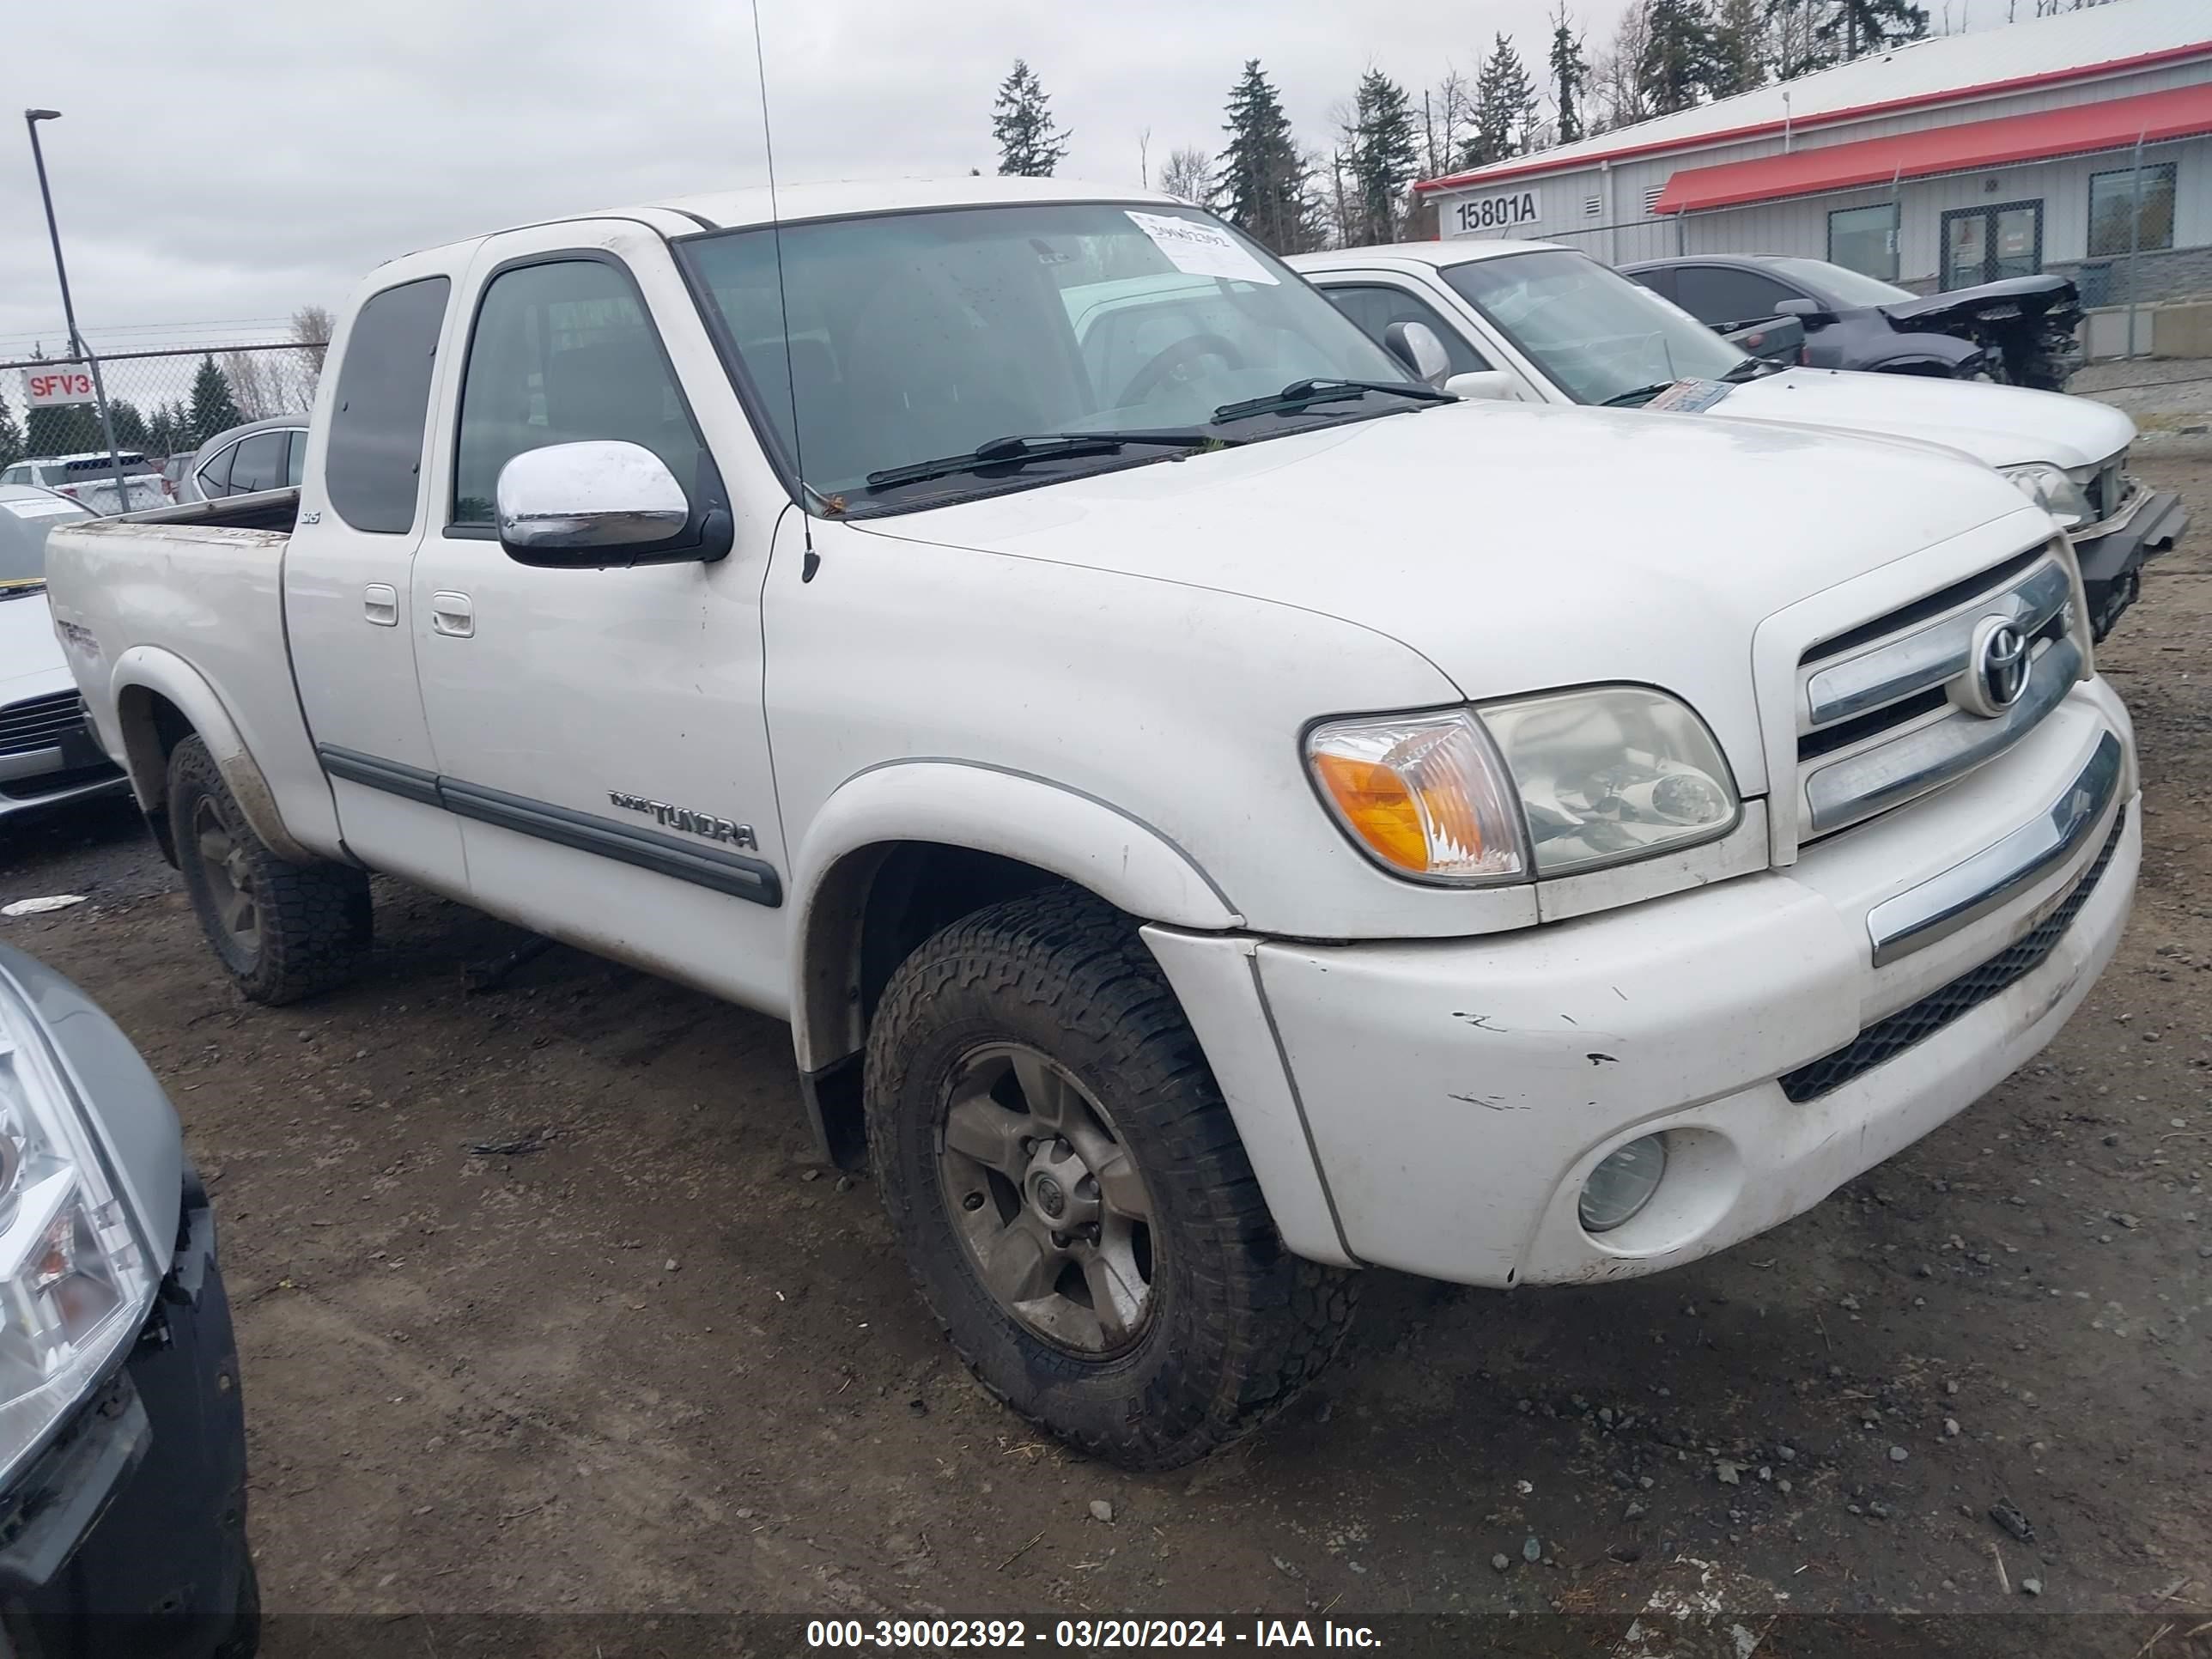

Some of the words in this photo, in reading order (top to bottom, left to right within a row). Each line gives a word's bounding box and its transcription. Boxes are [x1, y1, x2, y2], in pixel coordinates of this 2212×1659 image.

[1456, 192, 1537, 230] 15801A
[30, 374, 90, 397] SFV3
[648, 799, 758, 851] TUNDRA
